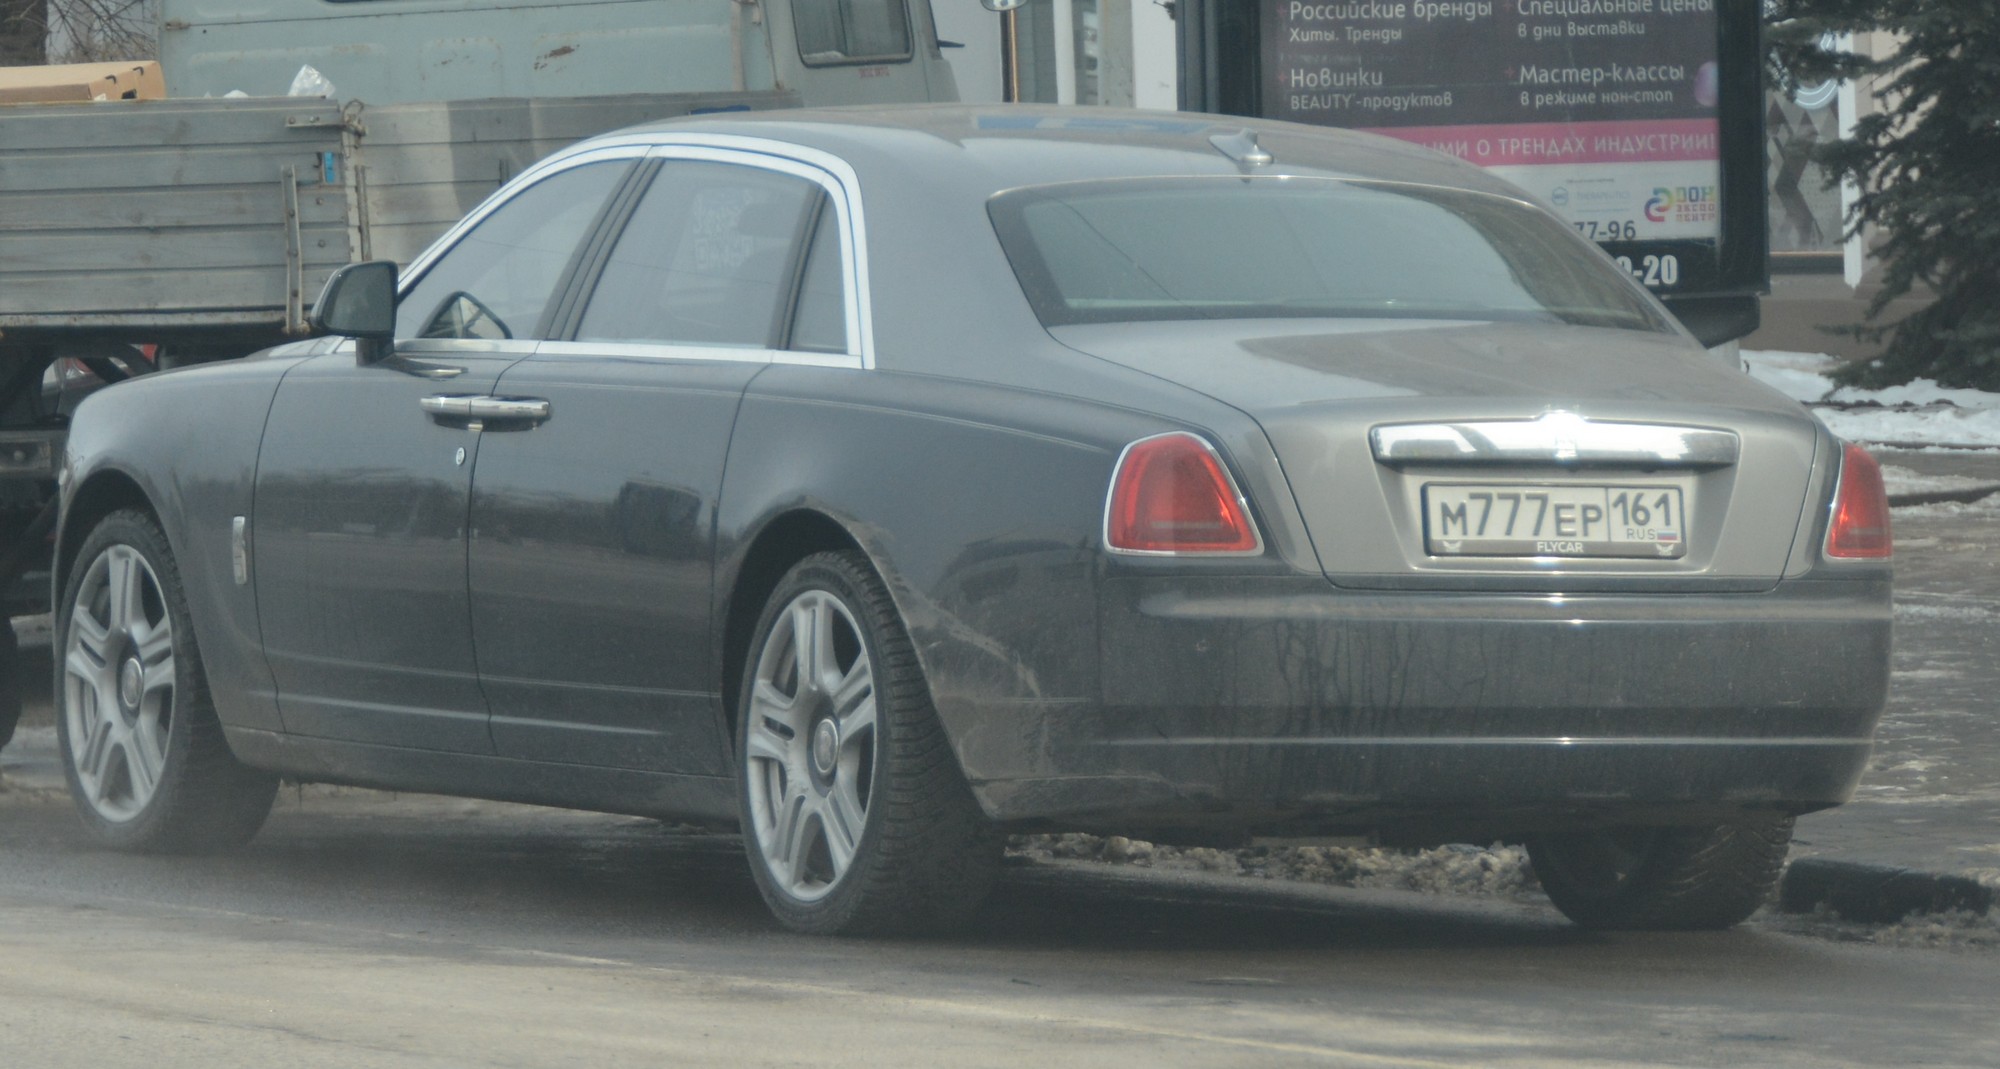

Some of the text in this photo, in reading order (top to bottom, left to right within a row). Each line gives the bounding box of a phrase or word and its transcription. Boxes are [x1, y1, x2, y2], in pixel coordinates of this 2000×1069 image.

[1290, 0, 1492, 21] Российские бренды
[1518, 0, 1713, 17] Специальные цены
[1290, 26, 1402, 44] Хиты. Тренды
[1518, 20, 1645, 40] в дни выставки
[1291, 67, 1383, 88] Новинки
[1520, 63, 1684, 87] Мастер-классы
[1520, 90, 1673, 109] в режиме нон-стоп
[1477, 139, 1490, 156] О
[1498, 136, 1585, 157] ТРЕНДАХ
[1594, 133, 1715, 153] ИНДУСТРИИ!
[1612, 492, 1671, 526] 161
[1626, 528, 1656, 540] RUS
[1537, 541, 1583, 553] FLYCAR
